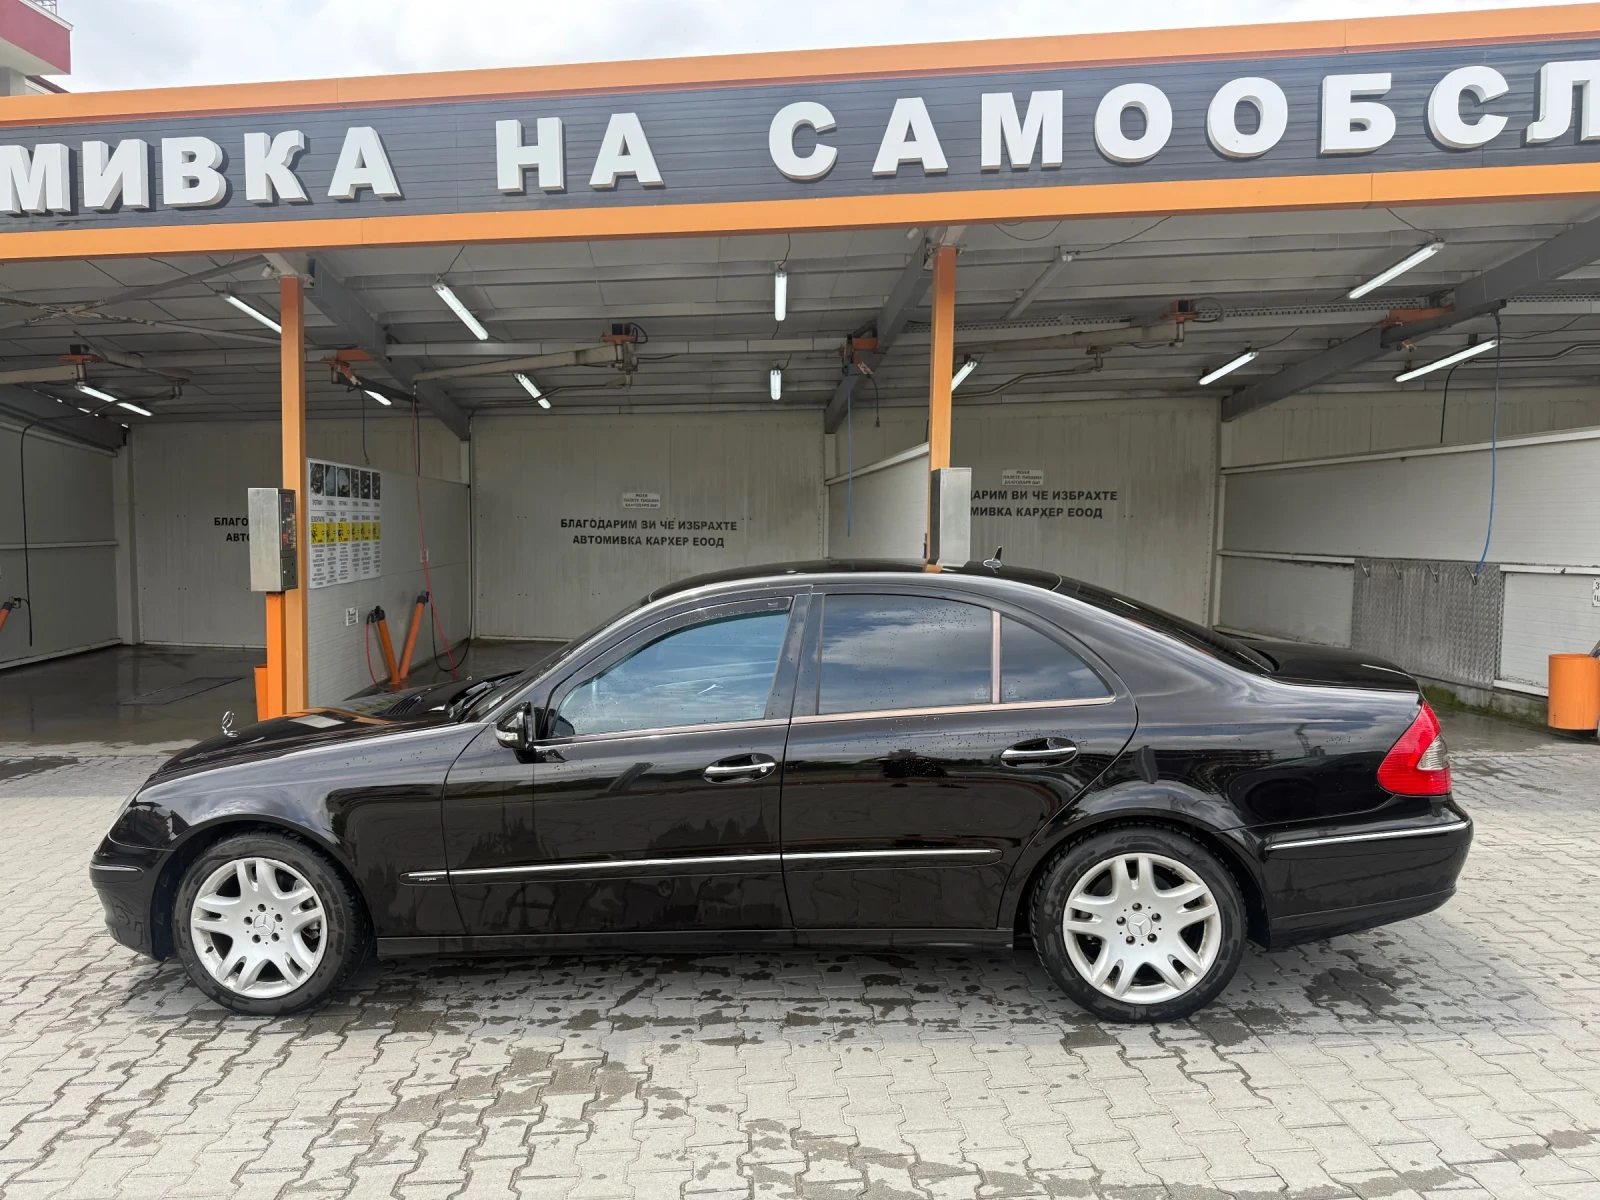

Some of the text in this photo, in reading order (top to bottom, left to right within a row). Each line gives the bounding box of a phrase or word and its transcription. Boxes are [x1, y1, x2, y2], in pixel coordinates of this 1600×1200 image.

[495, 111, 664, 194] НА
[971, 490, 1118, 501] АРИМ ВИ ЧЕ ИЗБРАХТЕ
[1016, 507, 1064, 518] КАРХЕР
[1067, 508, 1103, 519] ЕООД
[214, 517, 249, 526] БЛАГО
[560, 518, 737, 531] БЛАГОДАРИМ ВИ ЧЕ ИЗБРАХТЕ
[572, 535, 725, 548] АВТОМИВКА КАРХЕР ЕООД
